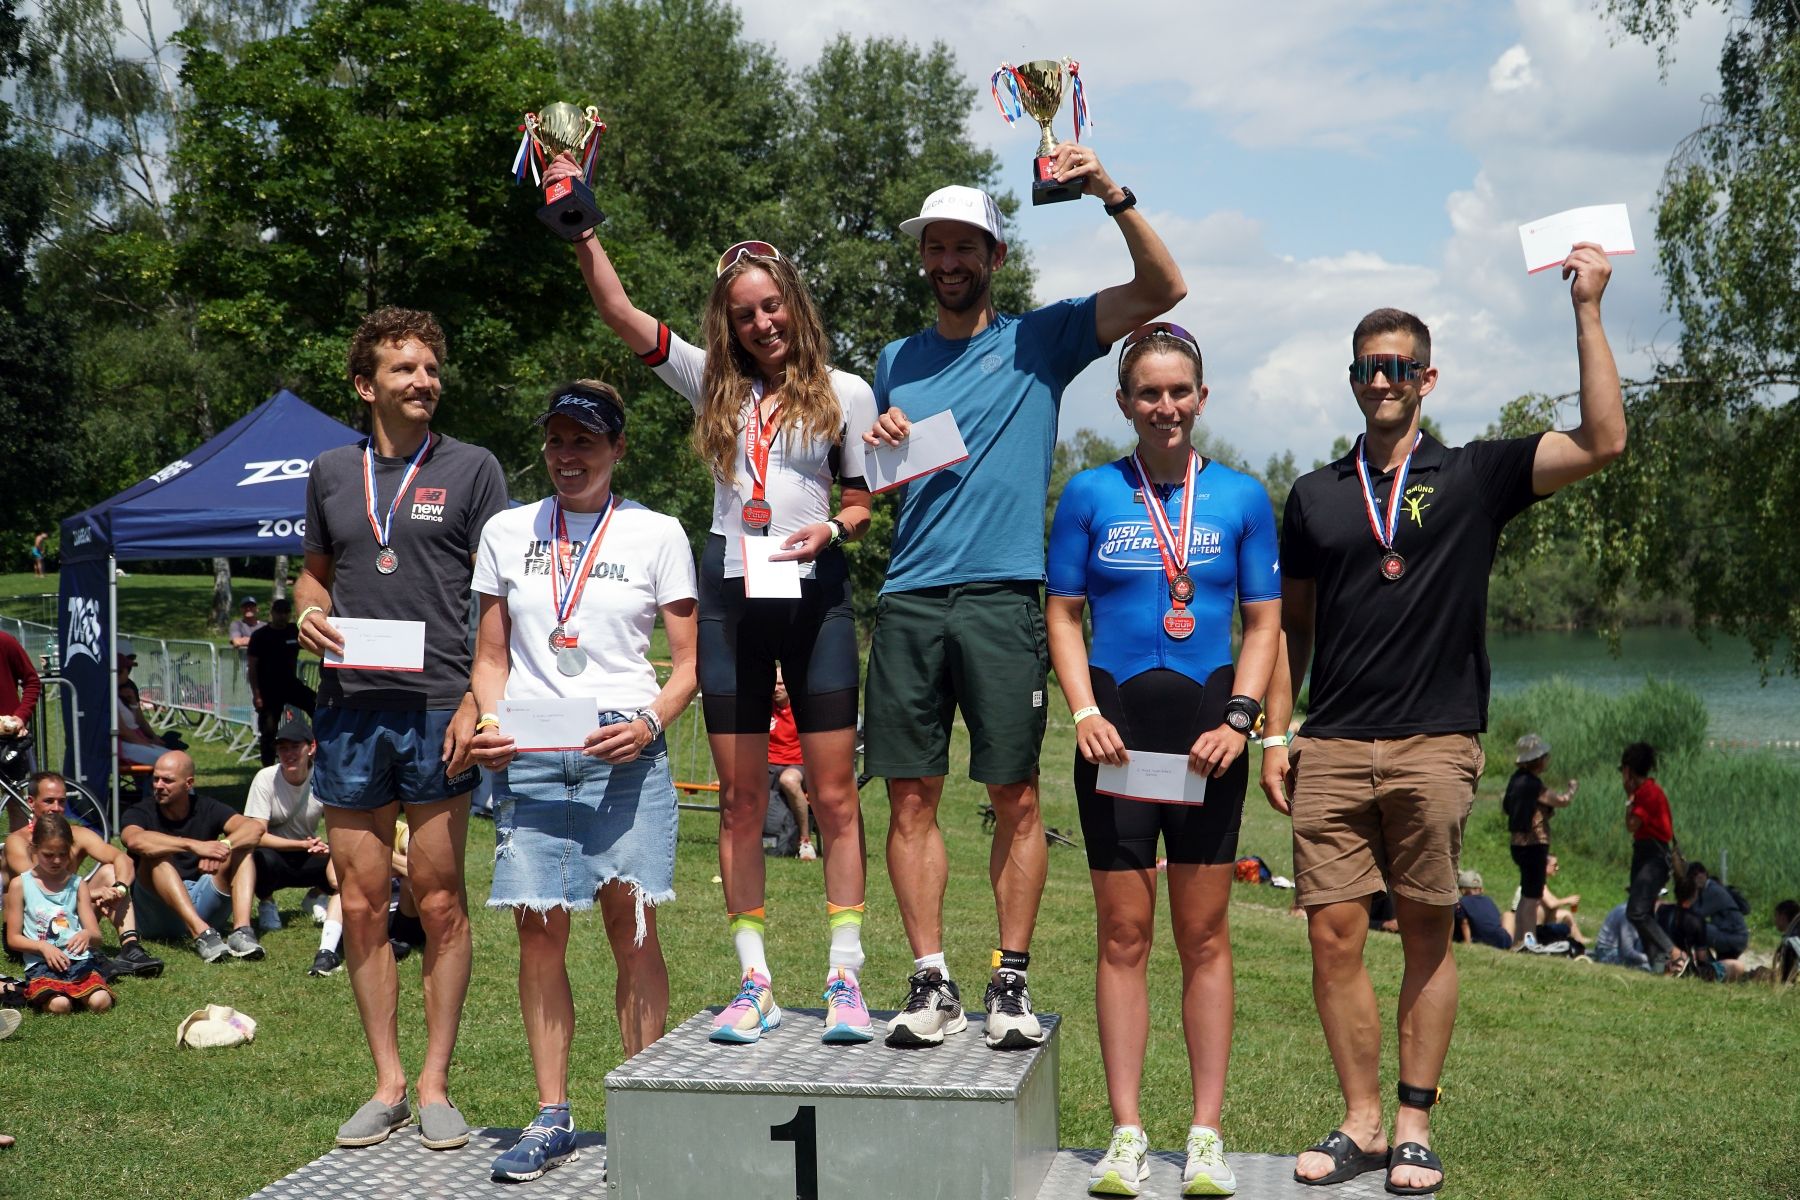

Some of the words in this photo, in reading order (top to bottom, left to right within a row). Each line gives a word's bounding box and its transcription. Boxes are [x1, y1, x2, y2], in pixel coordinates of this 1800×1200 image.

[236, 458, 315, 487] ZO
[412, 504, 445, 515] new
[411, 513, 444, 523] balance
[1108, 525, 1140, 541] WSV
[447, 772, 473, 786] adidas
[769, 1105, 819, 1200] 1
